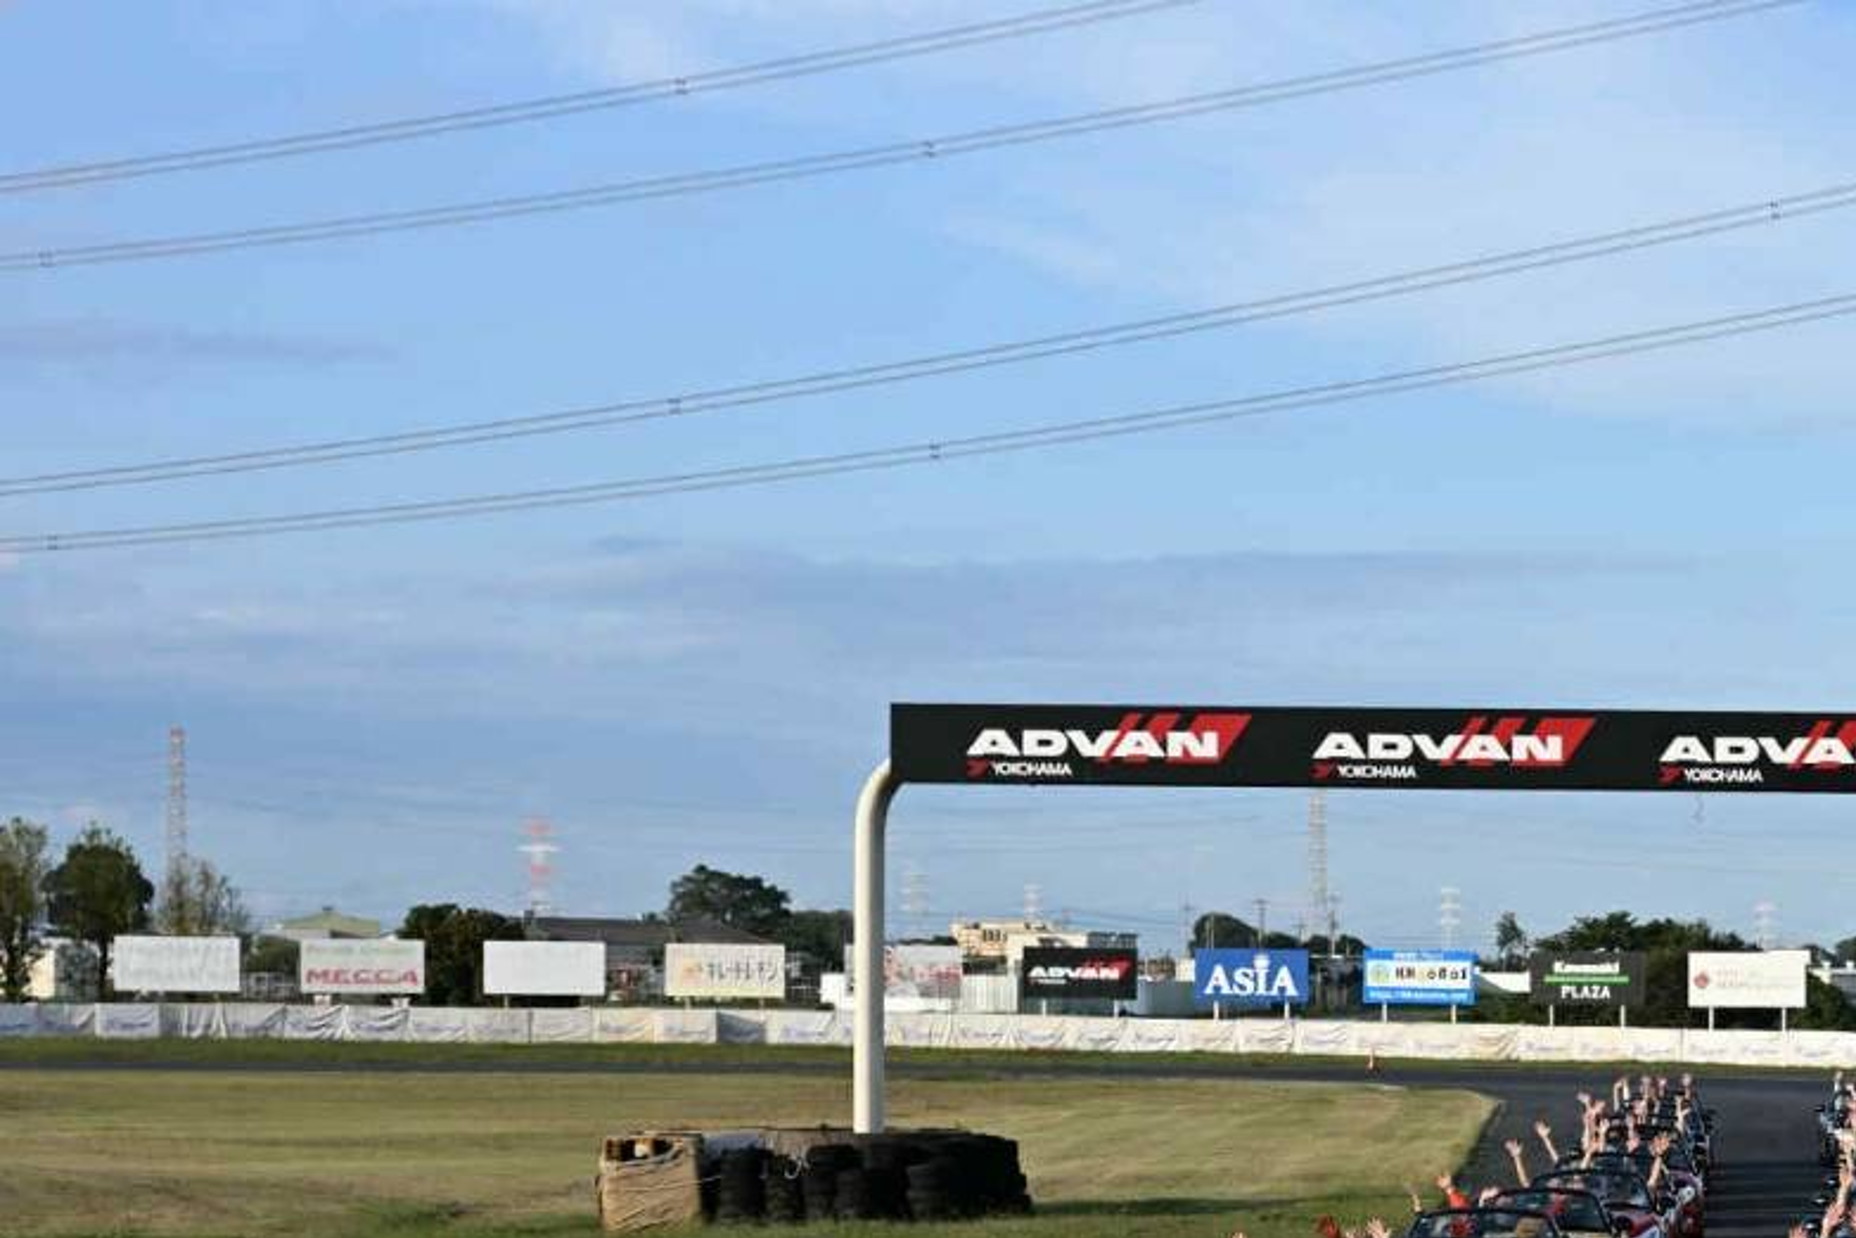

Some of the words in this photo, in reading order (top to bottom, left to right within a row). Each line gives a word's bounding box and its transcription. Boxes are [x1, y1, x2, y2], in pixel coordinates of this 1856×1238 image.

[967, 729, 1219, 758] ADVAN
[1313, 732, 1562, 761] ADVAN
[991, 762, 1072, 776] YOKOHAMA
[1337, 765, 1416, 779] YOKOHAMA
[1684, 768, 1763, 783] YOKOHAMA
[306, 967, 419, 985] MECCA
[1028, 966, 1120, 979] ADVAN
[1204, 964, 1298, 997] ASIA
[1561, 985, 1612, 1000] PLAZA
